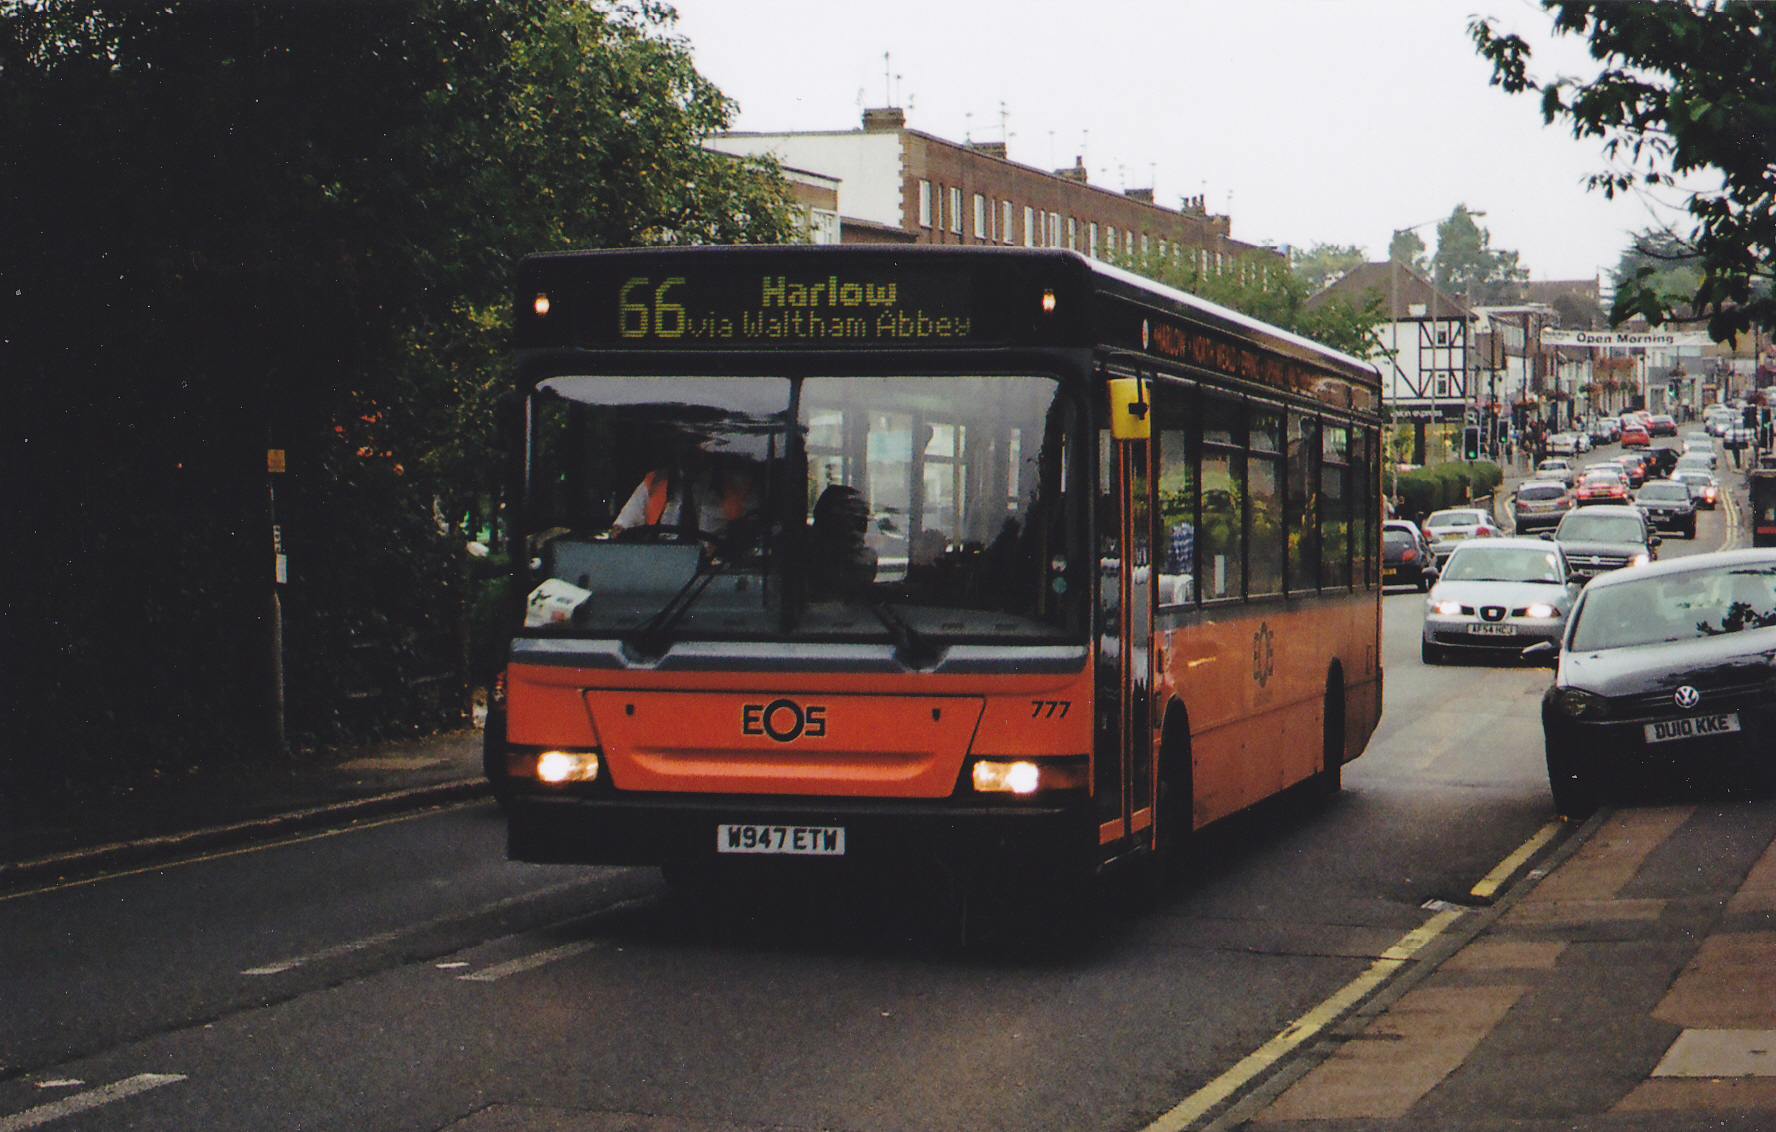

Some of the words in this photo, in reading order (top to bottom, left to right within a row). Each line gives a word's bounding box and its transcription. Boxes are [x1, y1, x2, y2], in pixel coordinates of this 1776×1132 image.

[761, 276, 898, 306] Harlow
[619, 276, 686, 338] 66
[686, 311, 733, 338] via
[743, 311, 867, 338] Waltham
[875, 310, 971, 338] Abbey
[1577, 332, 1611, 344] Open
[1617, 333, 1674, 345] Morning
[742, 698, 826, 742] EOS
[1031, 700, 1072, 719] 777
[1654, 719, 1693, 740] DU10
[1695, 714, 1730, 734] KKE
[728, 826, 787, 849] W947
[793, 828, 838, 851] ETW
